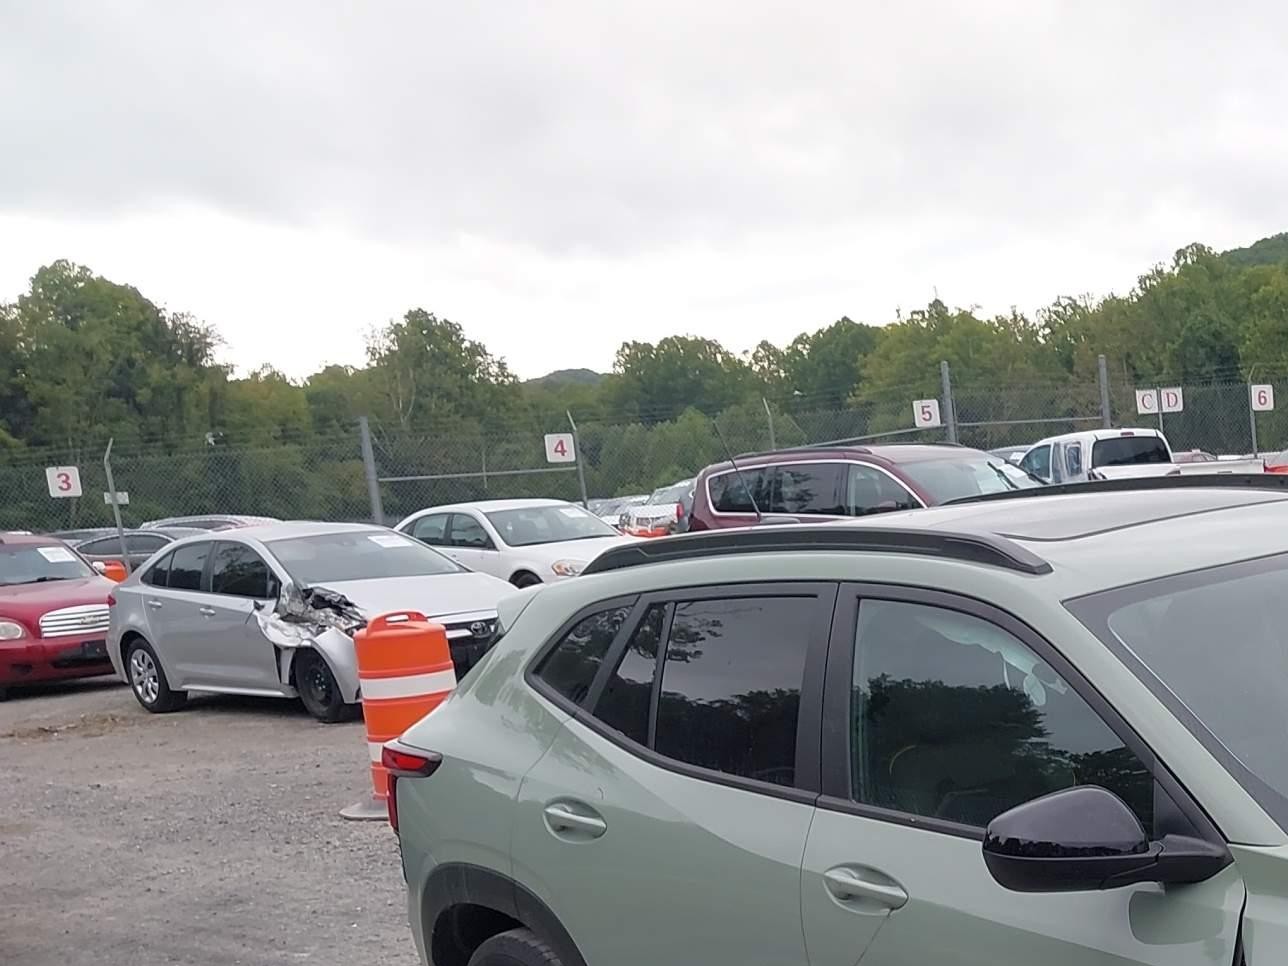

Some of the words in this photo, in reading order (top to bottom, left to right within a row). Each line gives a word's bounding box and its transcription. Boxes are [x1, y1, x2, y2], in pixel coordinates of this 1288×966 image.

[1141, 393, 1154, 409] C
[1166, 392, 1178, 408] D
[1258, 390, 1268, 406] 6
[921, 405, 932, 421] 5
[554, 439, 567, 456] 4
[57, 472, 71, 491] 3
